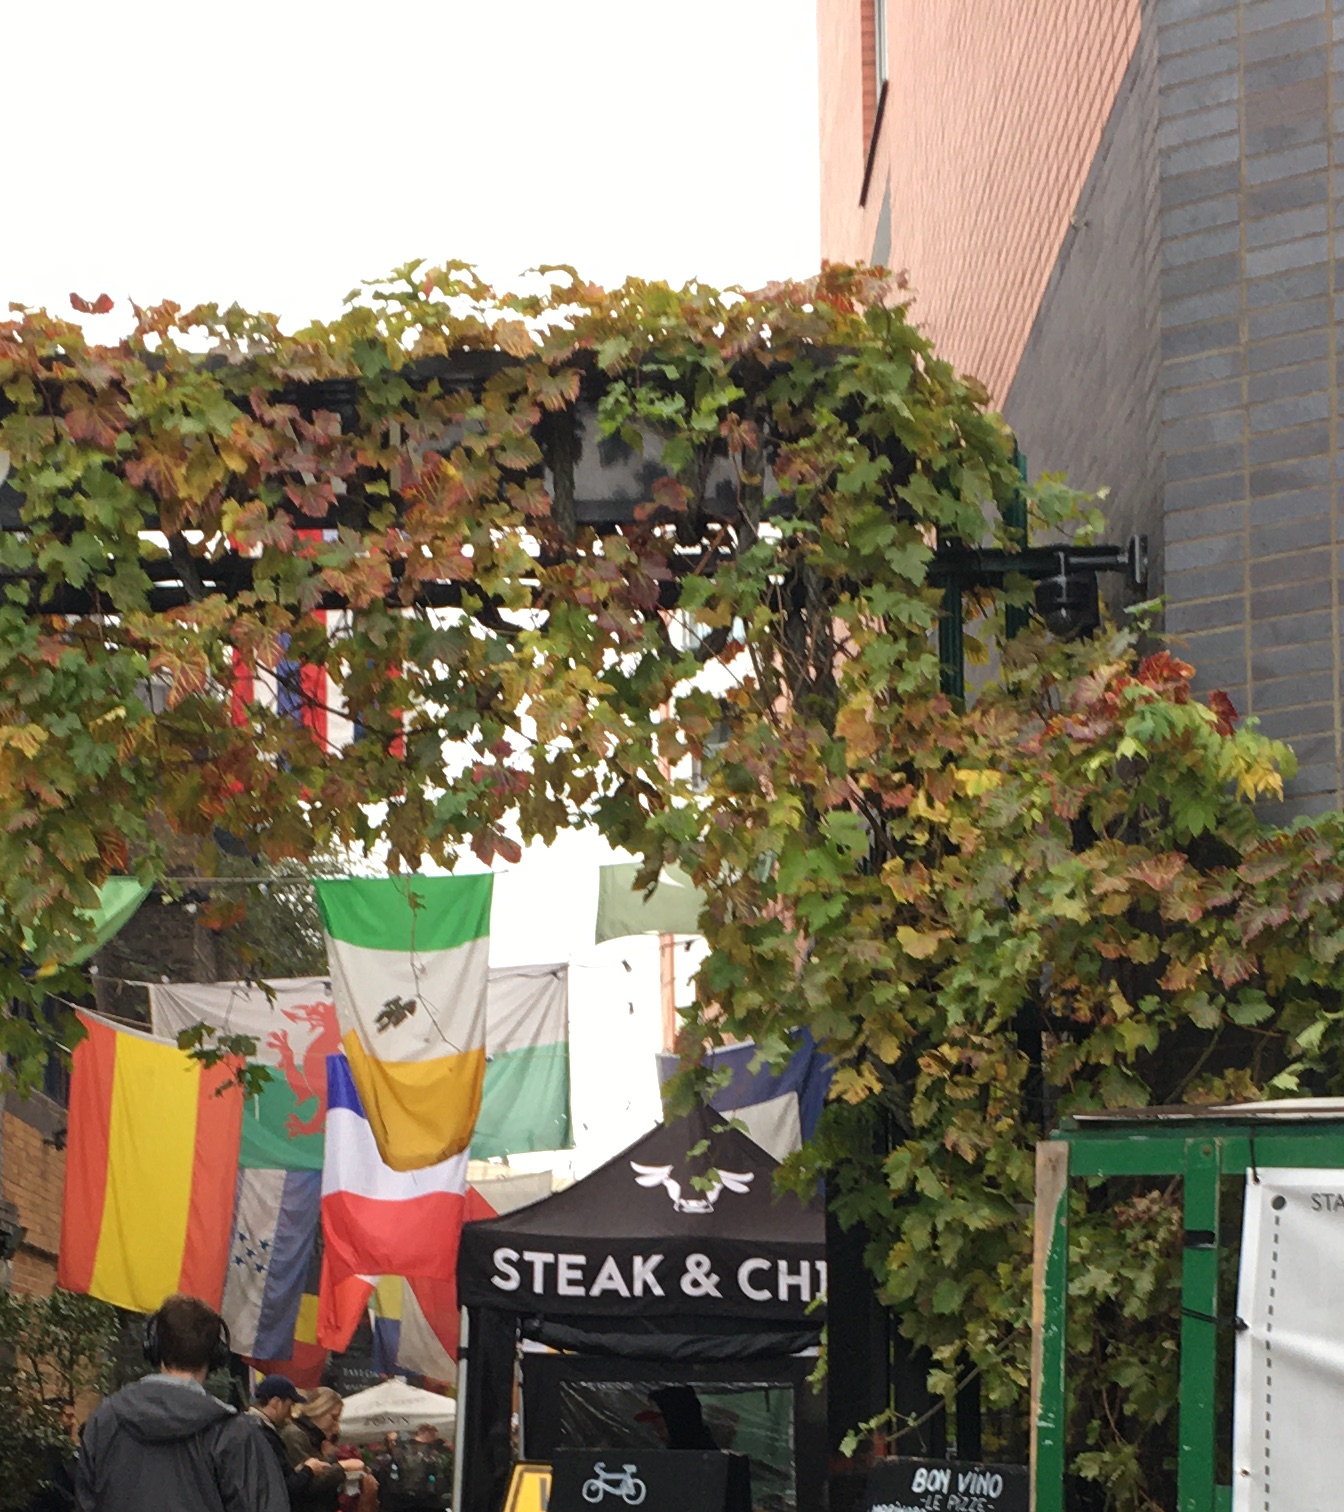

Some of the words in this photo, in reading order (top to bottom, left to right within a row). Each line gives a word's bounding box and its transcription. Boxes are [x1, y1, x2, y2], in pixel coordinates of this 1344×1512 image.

[490, 1247, 666, 1298] STEAK
[680, 1253, 723, 1298] &
[912, 1467, 951, 1494] BON
